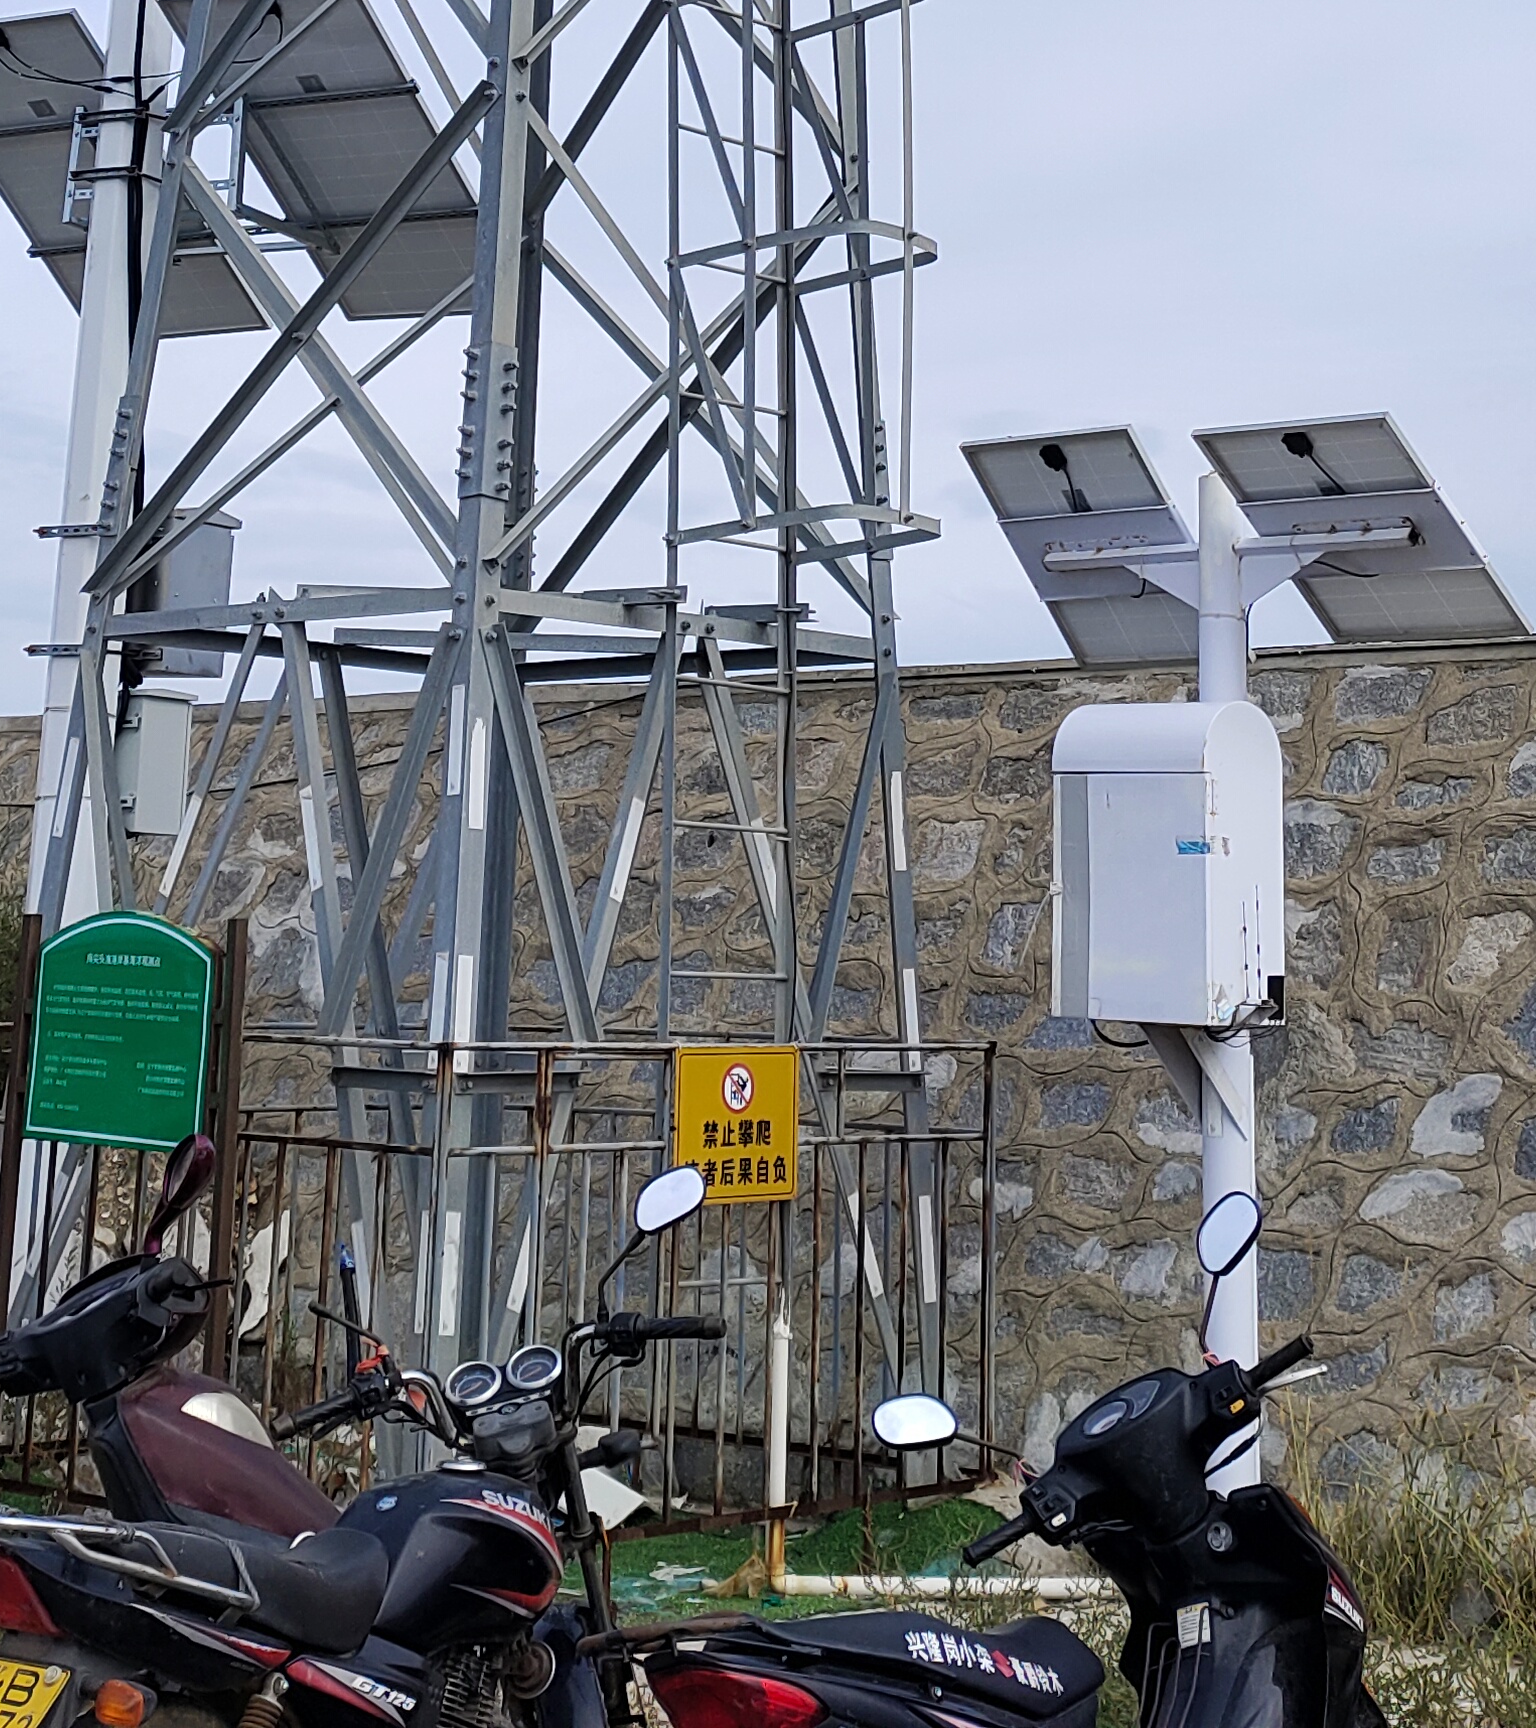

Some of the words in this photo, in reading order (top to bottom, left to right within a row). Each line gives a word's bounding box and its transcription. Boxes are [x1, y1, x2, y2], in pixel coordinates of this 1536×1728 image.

[702, 1119, 772, 1149] 禁止攀爬
[684, 1155, 787, 1187] 者后果自负
[481, 1489, 552, 1533] SUZUKI
[351, 1676, 417, 1711] GT125
